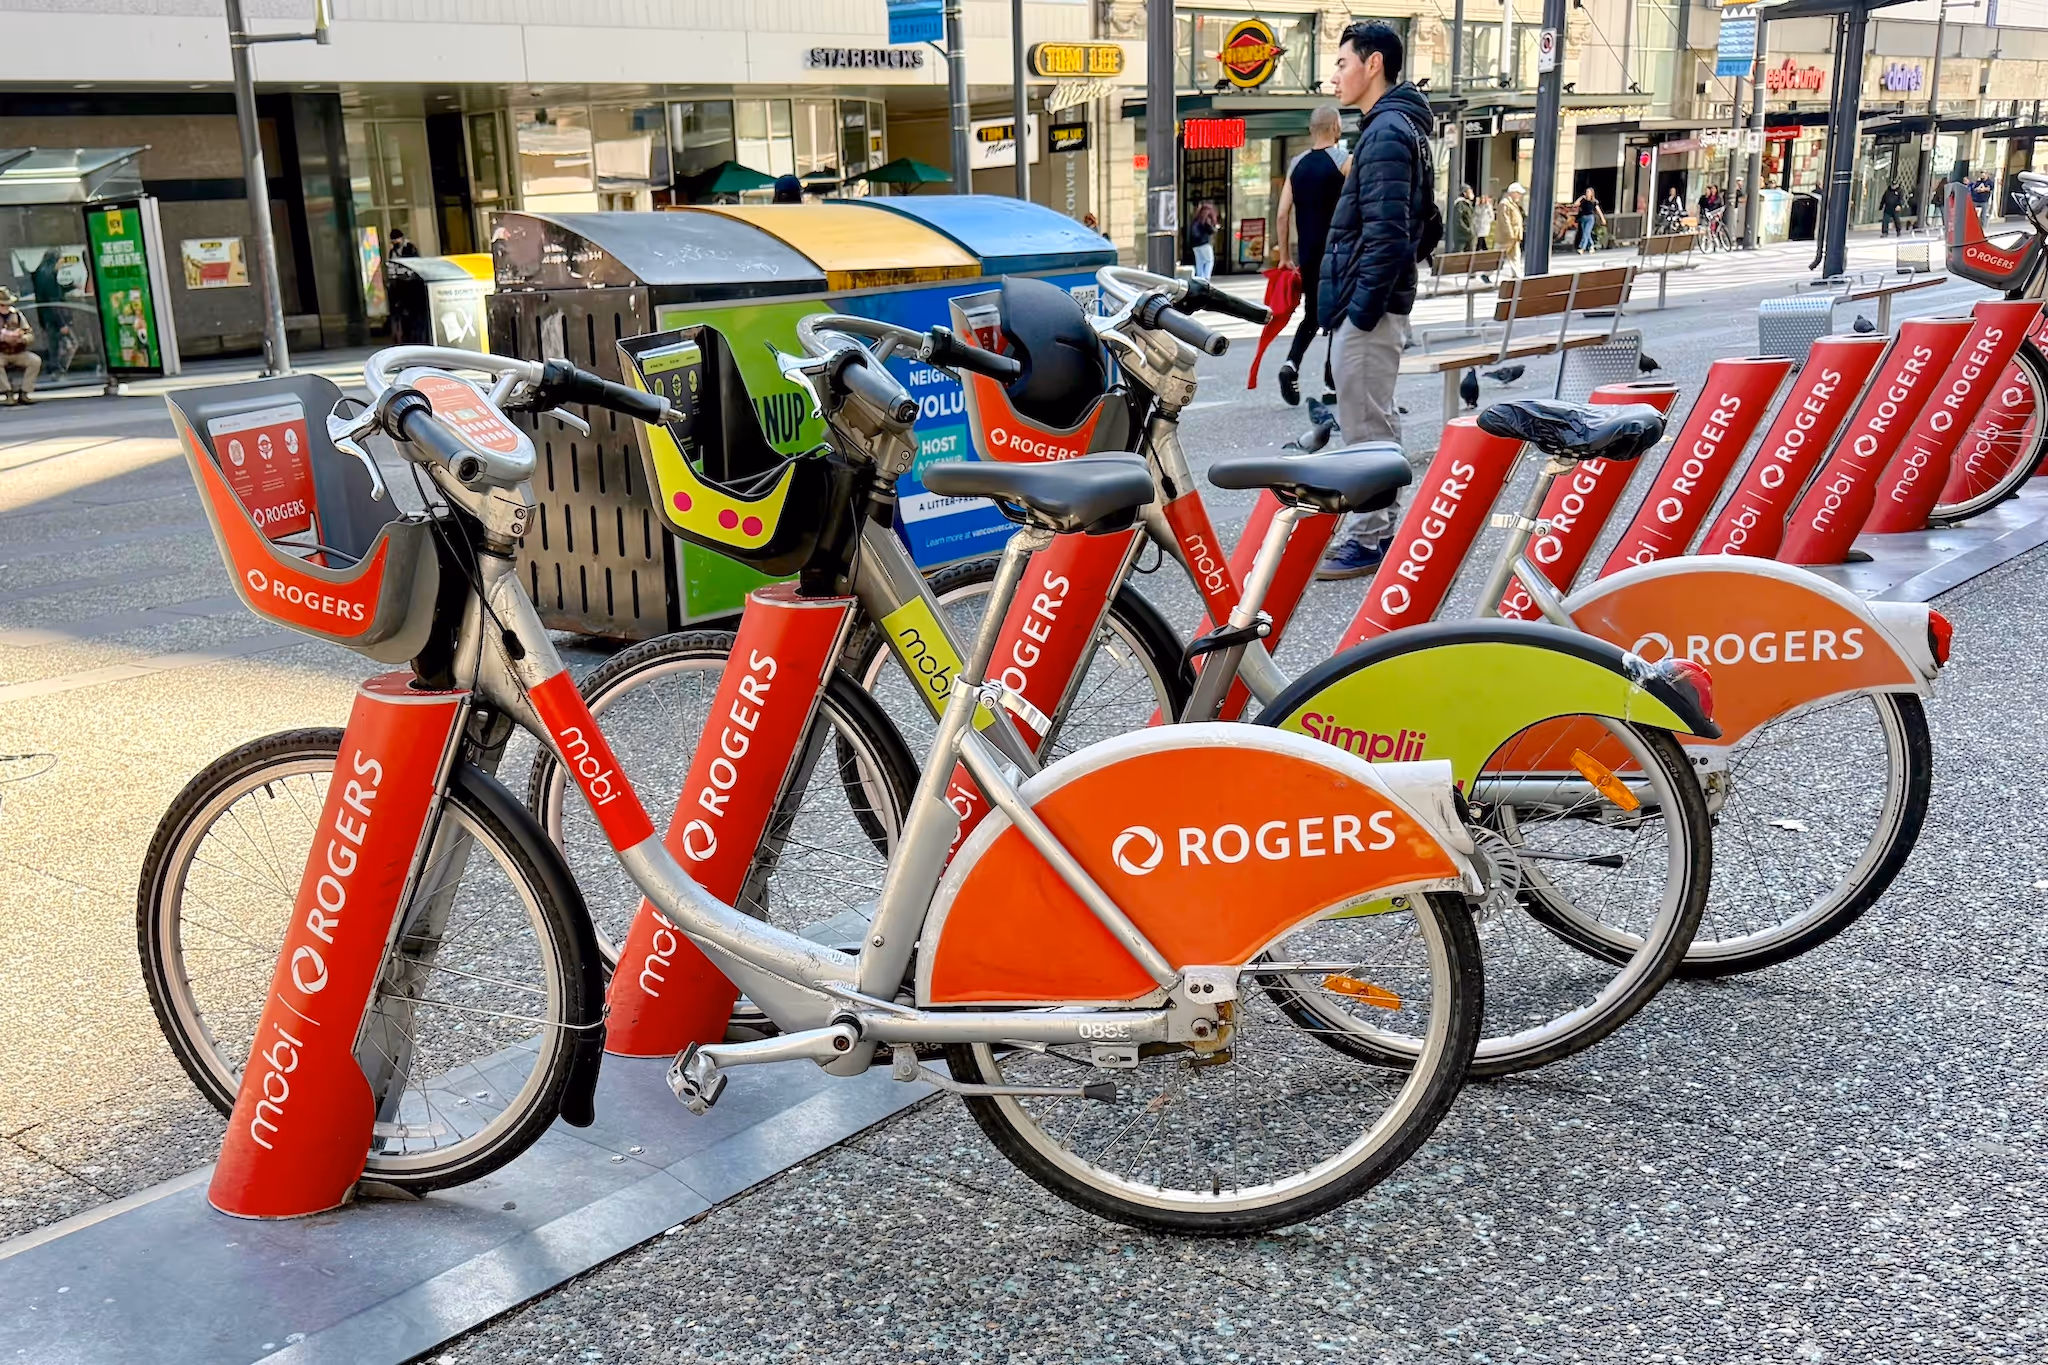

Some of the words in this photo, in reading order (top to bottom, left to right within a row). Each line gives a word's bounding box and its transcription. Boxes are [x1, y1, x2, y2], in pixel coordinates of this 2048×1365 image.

[808, 47, 924, 69] STARBUCKS
[1045, 46, 1084, 73] TOM
[1088, 46, 1122, 72] LEE
[1753, 58, 1827, 94] eepCountry
[1885, 62, 1923, 91] claire's
[1184, 118, 1246, 149] FATBURGER
[1065, 161, 1076, 219] COUVER
[1977, 251, 2015, 270] ROGERS
[1869, 344, 1933, 434] ROGERS
[1944, 325, 2004, 410] ROGERS
[752, 392, 805, 445] NUP
[917, 395, 967, 421] VOLU
[1775, 368, 1842, 464] ROGERS
[921, 435, 957, 456] HOST
[1009, 435, 1079, 461] ROGERS
[1677, 393, 1741, 496] ROGERS
[1965, 420, 2003, 474] mobi
[1552, 460, 1606, 534] ROGE
[1891, 446, 1932, 503] mobi
[265, 499, 306, 525] ROGERS
[919, 503, 925, 511] A
[1398, 459, 1475, 582] ROGERS
[1811, 471, 1856, 533] mobi
[926, 537, 945, 548] Learn
[946, 534, 963, 544] more
[964, 531, 971, 540] at
[1185, 533, 1230, 597] mobi
[1626, 540, 1660, 566] bi
[272, 579, 366, 623] ROGERS
[1001, 569, 1070, 697] OGERS
[1687, 628, 1865, 666] ROGERS
[899, 627, 954, 701] mobi
[698, 648, 778, 818] ROGERS
[1301, 712, 1427, 763] Simplii
[560, 726, 622, 806] mobi
[306, 748, 384, 945] ROGERS
[1178, 810, 1397, 868] ROGERS
[250, 1022, 303, 1151] mobi
